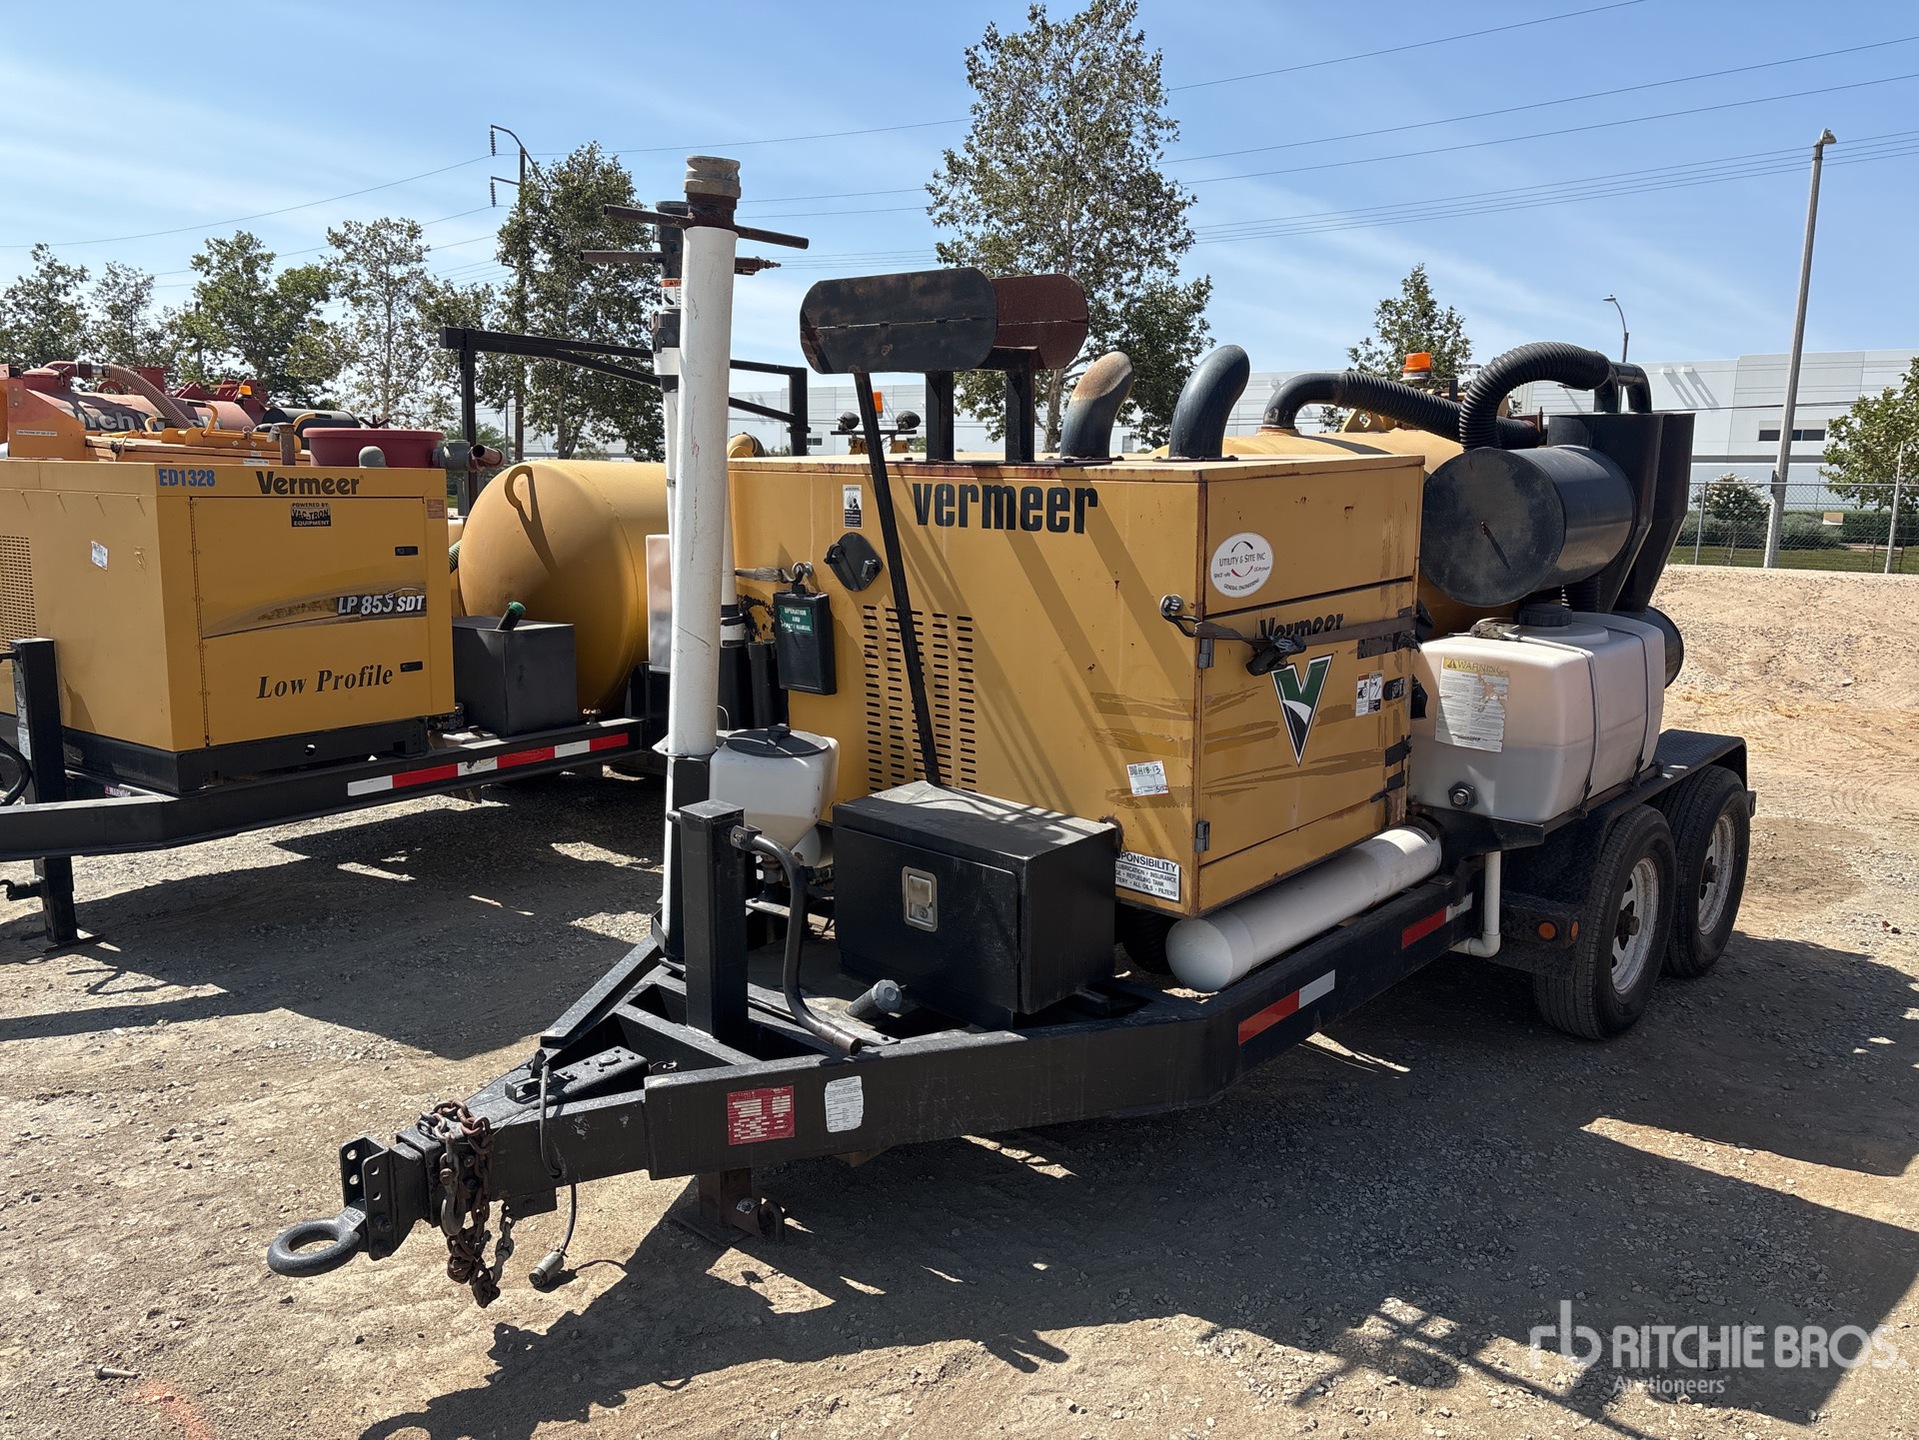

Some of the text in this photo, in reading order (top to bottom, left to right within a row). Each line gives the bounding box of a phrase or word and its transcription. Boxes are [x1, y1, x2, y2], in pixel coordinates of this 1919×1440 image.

[158, 468, 216, 487] ED1328
[255, 470, 360, 495] Vermeer
[912, 482, 1099, 534] vermeer
[1219, 556, 1239, 567] UTILITY
[1244, 553, 1256, 563] SITE
[1256, 552, 1266, 561] INC
[337, 594, 425, 615] LP 855 SDT
[1458, 660, 1503, 674] WARNING
[256, 664, 393, 699] Low Profile
[1126, 872, 1151, 884] REFUELING
[1153, 879, 1165, 887] TANK
[1150, 872, 1177, 884] INSURANCE
[1142, 883, 1153, 891] OILS
[1158, 887, 1177, 897] FILTERS
